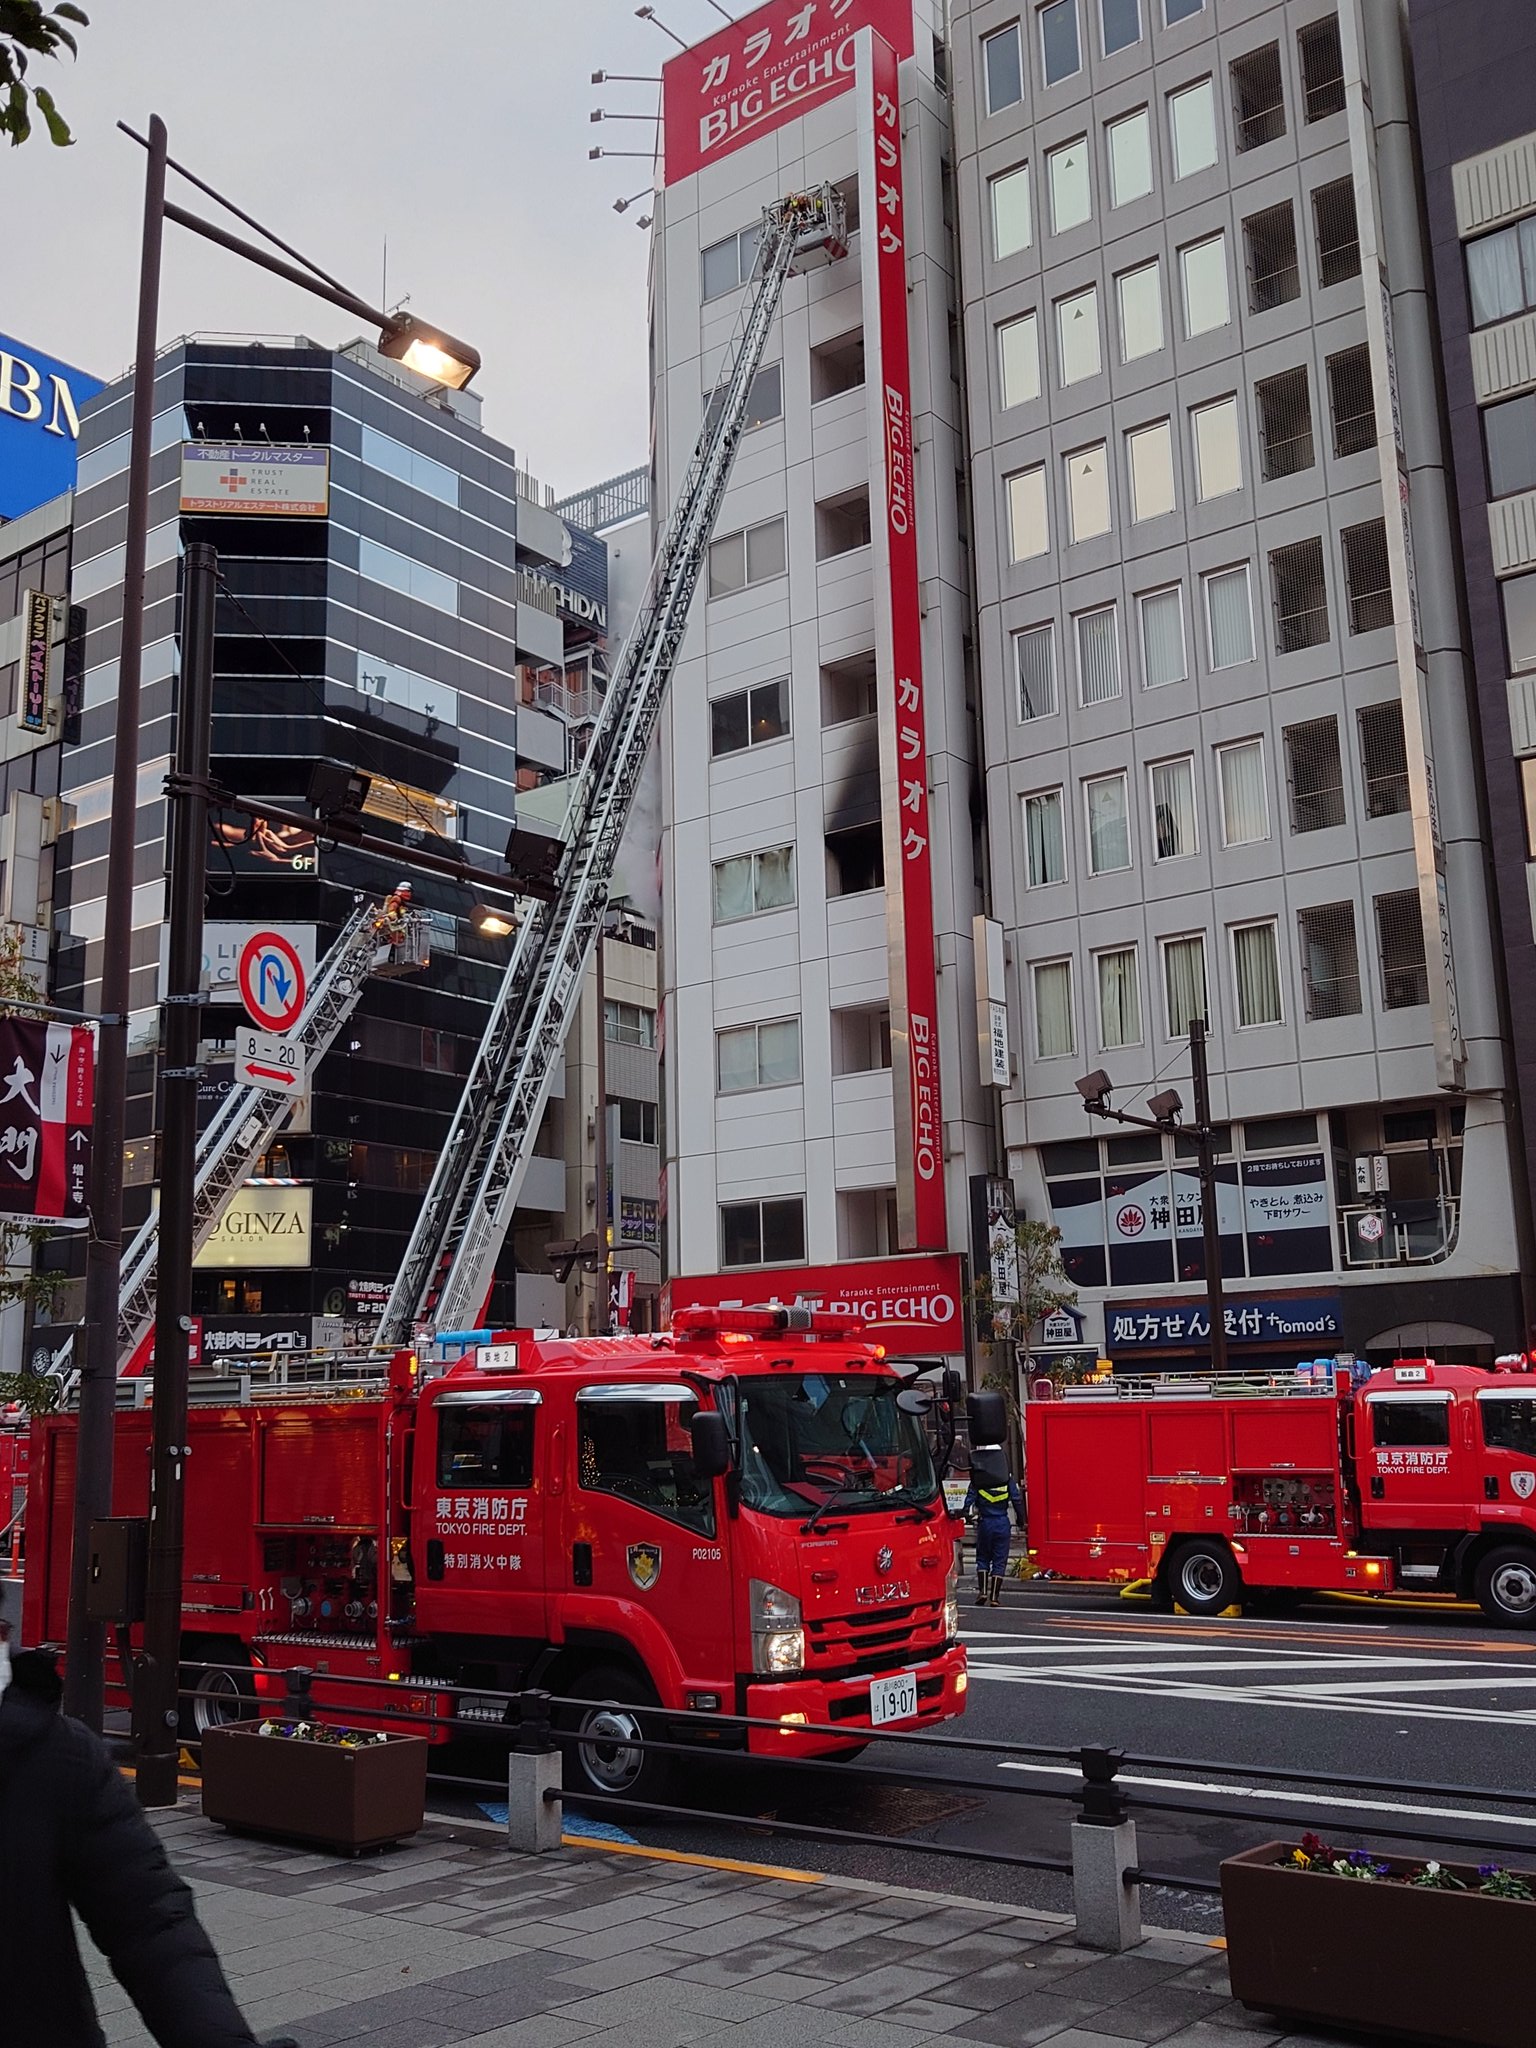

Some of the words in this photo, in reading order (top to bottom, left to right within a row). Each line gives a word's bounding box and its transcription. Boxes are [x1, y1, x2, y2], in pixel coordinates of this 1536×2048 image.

[713, 76, 758, 107] Karaoke
[763, 23, 850, 80] Entertainment
[700, 89, 762, 153] BIG
[770, 34, 857, 104] ECHO
[876, 91, 903, 254] カラオケ
[885, 384, 903, 448] BIG
[197, 449, 314, 462] 不動産トータルマスター
[251, 478, 276, 486] REAL
[905, 451, 914, 526] Entertainment
[251, 488, 290, 496] ESTATE
[891, 449, 908, 535] ECHO
[190, 500, 318, 512] トラストリアルエステート株式会社
[898, 679, 926, 861] カラオケ
[292, 855, 312, 871] 6F
[911, 1013, 930, 1078] BIG
[0, 1055, 40, 1181] 大門
[933, 1082, 942, 1165] Entertainment
[917, 1085, 935, 1180] ECHO
[1247, 1159, 1322, 1173] 2階でお待ちしております
[1357, 1166, 1366, 1184] 大衆
[72, 1163, 84, 1204] 増上寺
[1250, 1196, 1289, 1208] やきとん
[1293, 1193, 1323, 1205] 煮込み
[1264, 1208, 1311, 1220] 下町サワー
[840, 1287, 874, 1298] Karaoke
[877, 1283, 940, 1295] Entertainment
[357, 1302, 370, 1313] 2F
[882, 1294, 954, 1322] ECHO
[1046, 1328, 1072, 1339] 神田屋
[1277, 1315, 1336, 1334] Tomod's
[1376, 1452, 1448, 1465] 東京消防庁
[1377, 1466, 1405, 1474] TOKYO
[1406, 1466, 1425, 1474] FIRE
[1426, 1466, 1450, 1474] DEPT.
[436, 1497, 528, 1520] 東京消防庁
[436, 1522, 471, 1535] TOKYO
[472, 1523, 496, 1535] FIRE
[498, 1523, 528, 1536] DEPT.
[444, 1553, 522, 1570] 特別消火中隊
[692, 1548, 721, 1560] P02105
[855, 1580, 910, 1604] ISUZU
